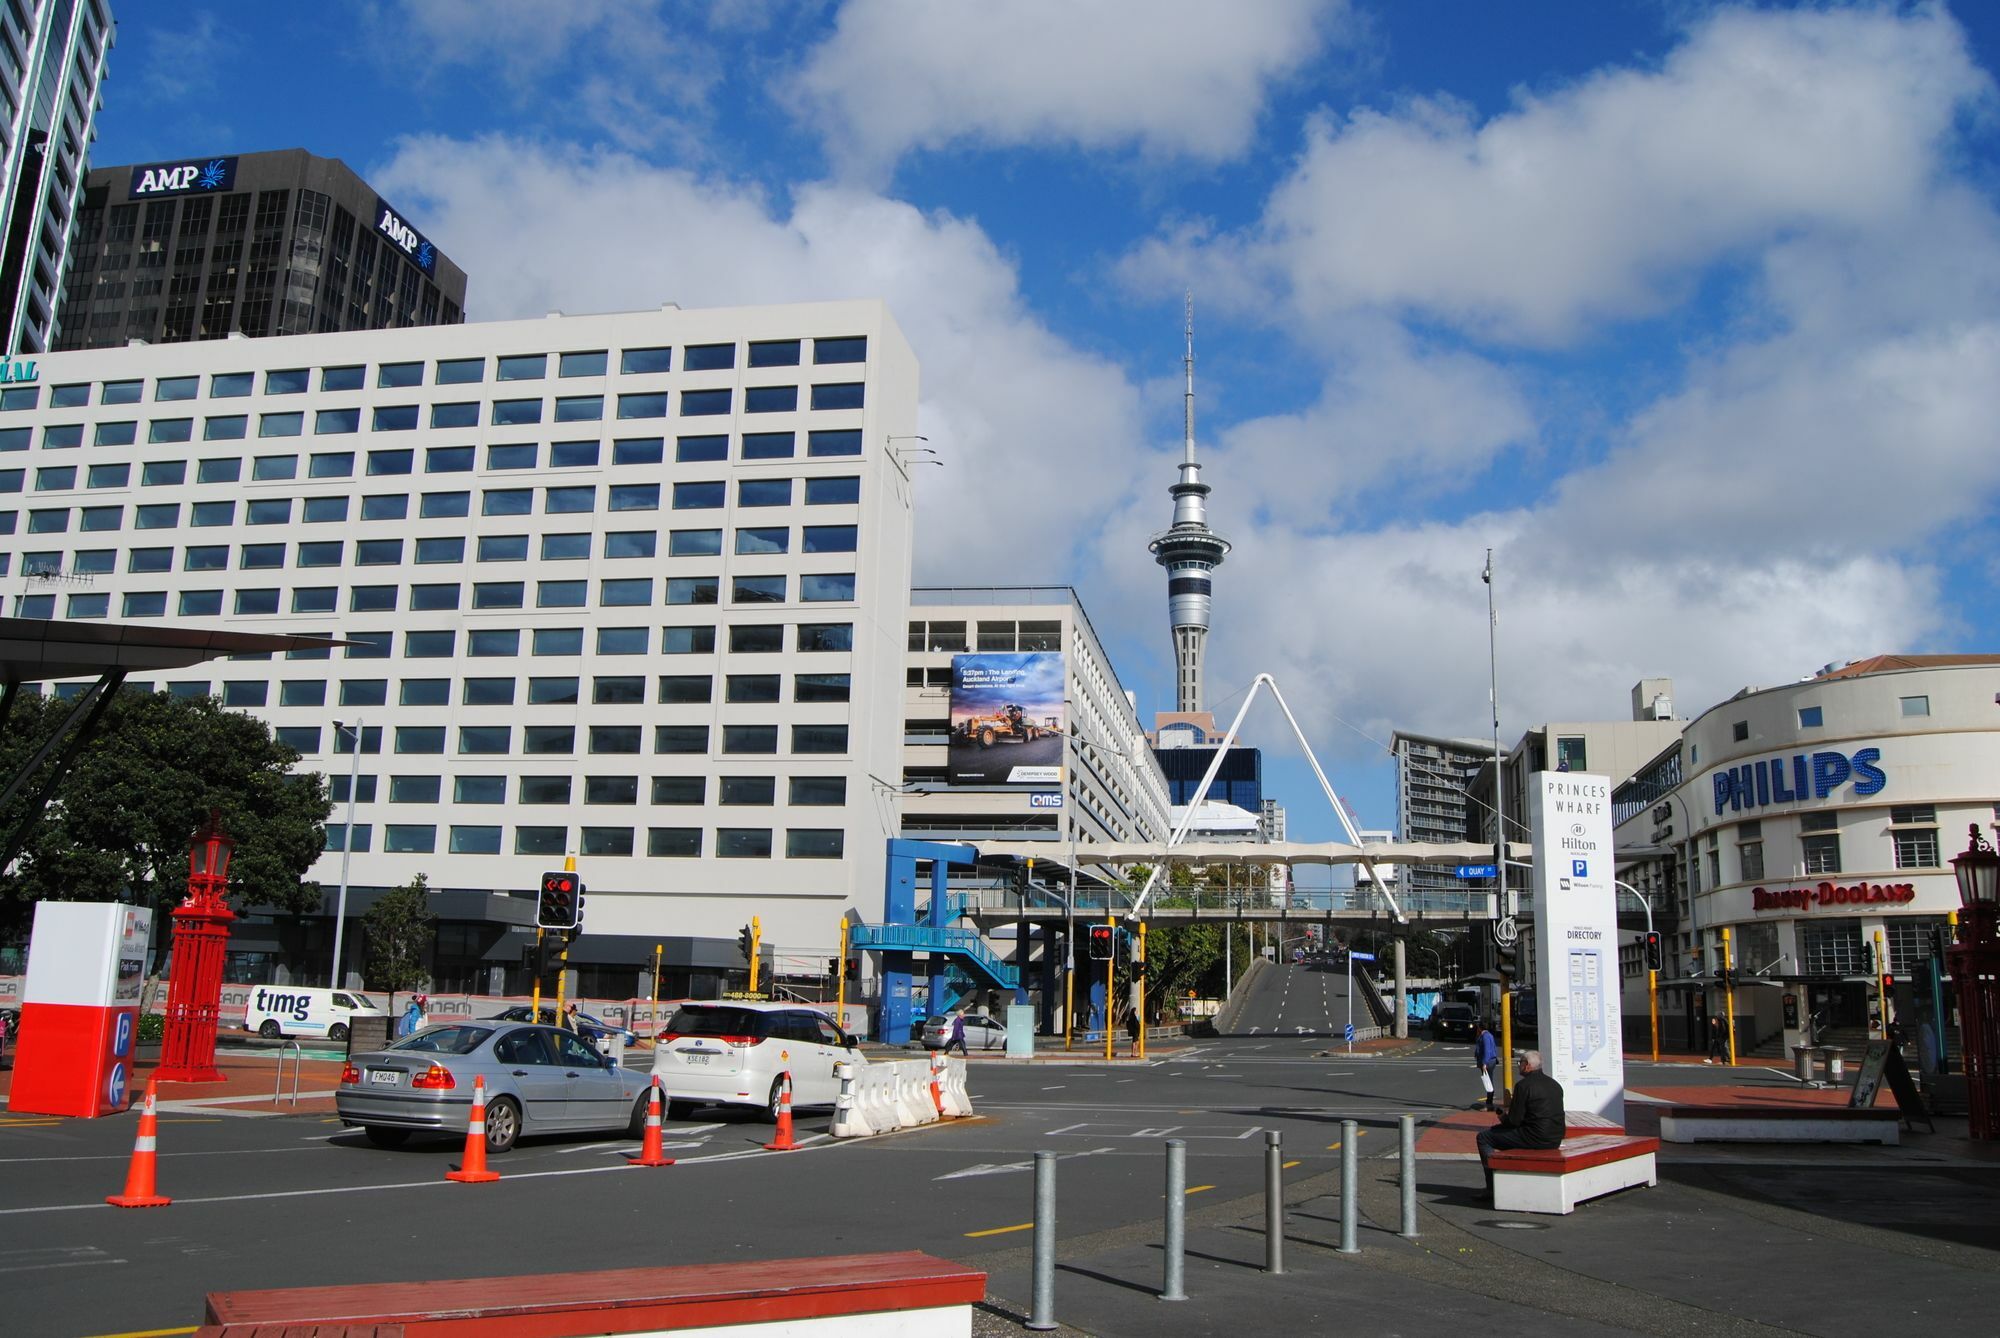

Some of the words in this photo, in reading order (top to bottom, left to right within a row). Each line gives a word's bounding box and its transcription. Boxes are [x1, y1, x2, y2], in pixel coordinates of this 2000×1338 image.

[136, 166, 199, 193] AMP
[379, 209, 418, 254] AMP
[1713, 747, 1887, 816] PHILIPS
[1548, 782, 1606, 798] PRINCES
[1031, 795, 1062, 806] QMS
[1555, 800, 1601, 815] WHARF
[1561, 837, 1597, 851] Hilton
[1468, 867, 1485, 875] QUAY
[1576, 862, 1585, 874] P
[1567, 930, 1602, 940] DIRECTORY
[256, 988, 311, 1021] timg
[120, 1019, 130, 1050] P
